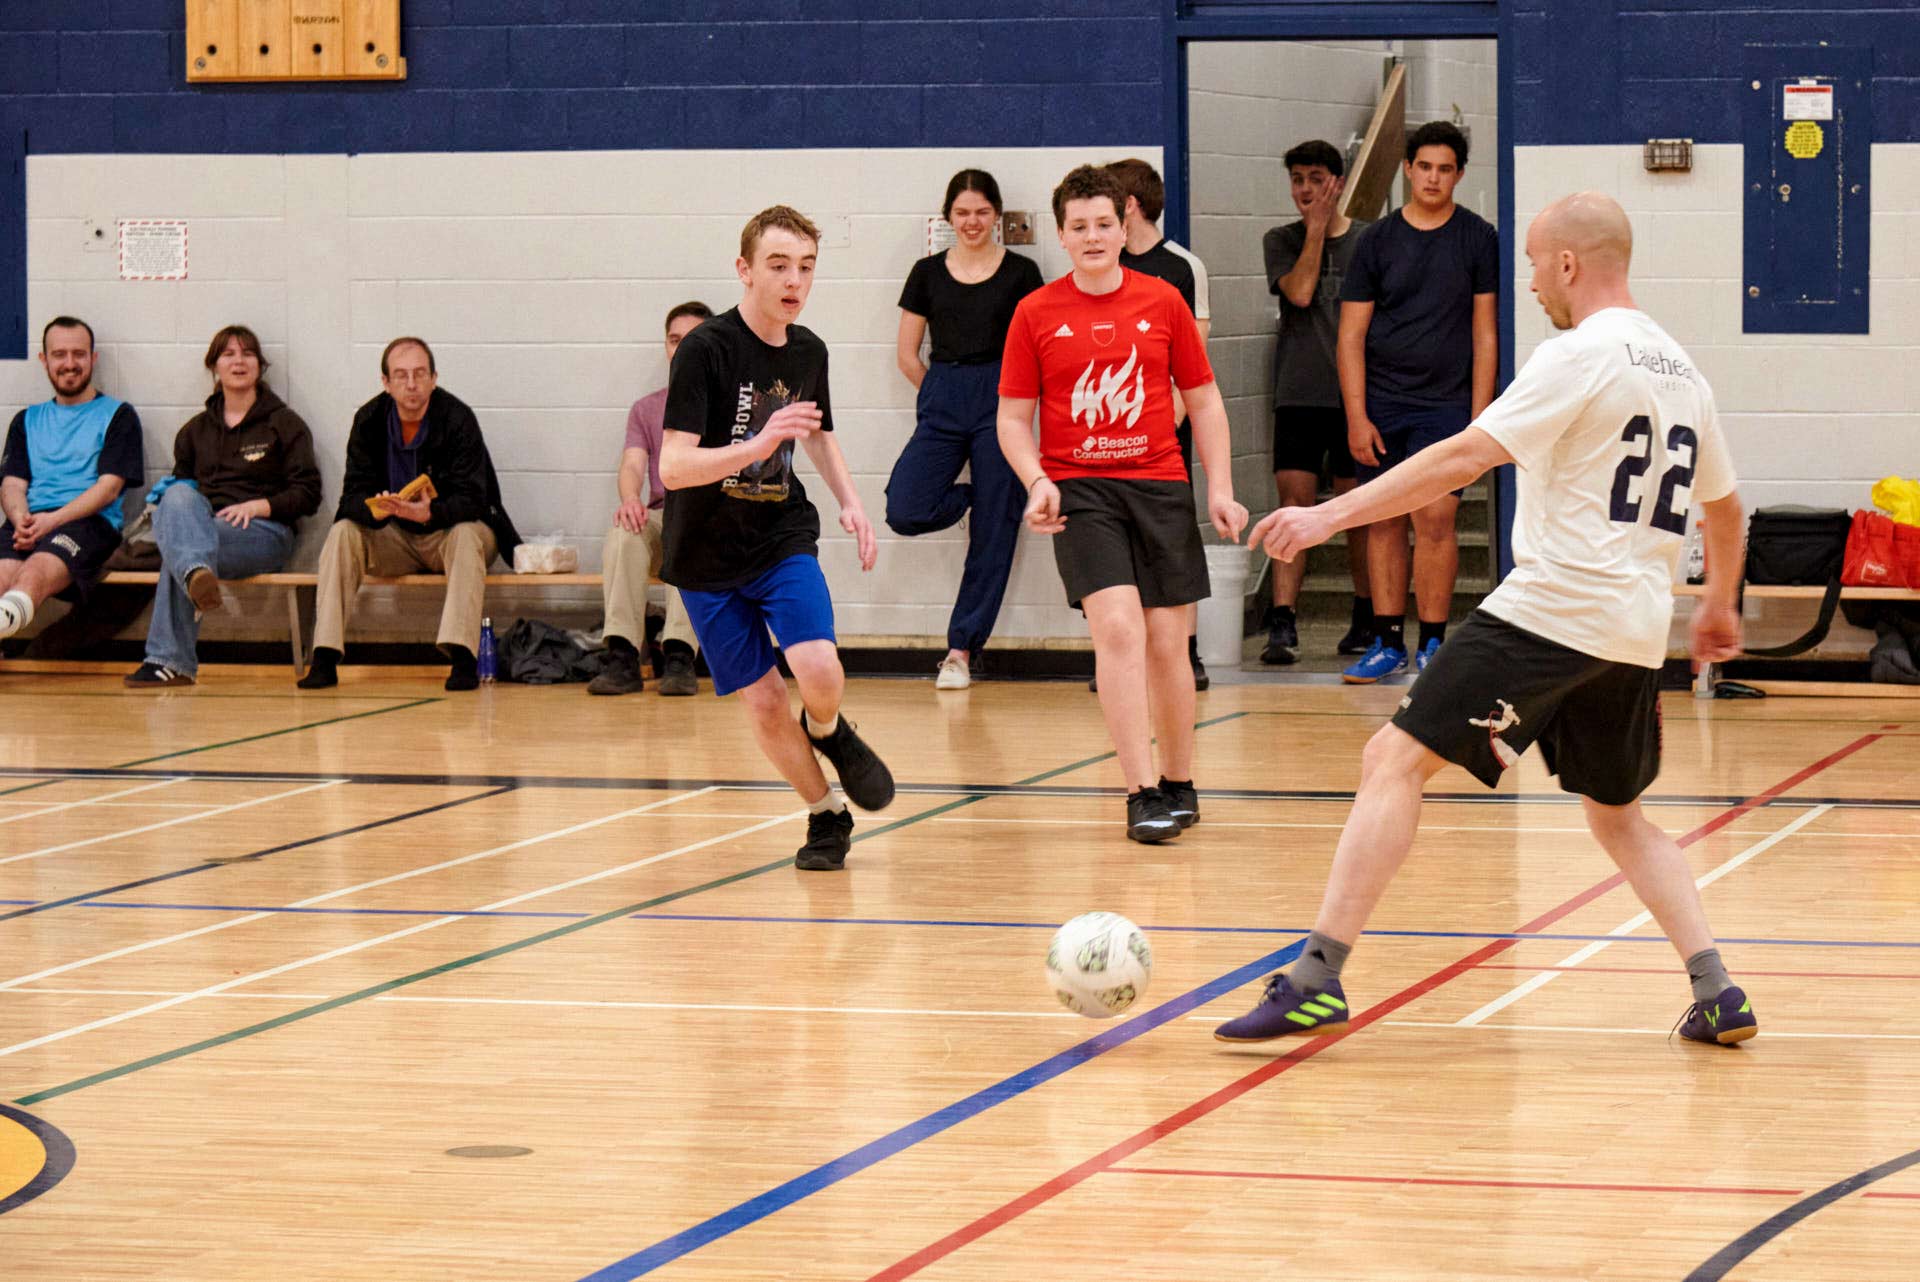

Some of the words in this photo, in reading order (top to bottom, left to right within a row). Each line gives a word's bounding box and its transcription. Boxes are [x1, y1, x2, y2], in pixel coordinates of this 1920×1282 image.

[731, 381, 754, 436] BOWL
[722, 437, 744, 490] BLD
[1073, 446, 1149, 459] Construction
[1098, 434, 1148, 449] Beacon
[1609, 414, 1698, 537] 22
